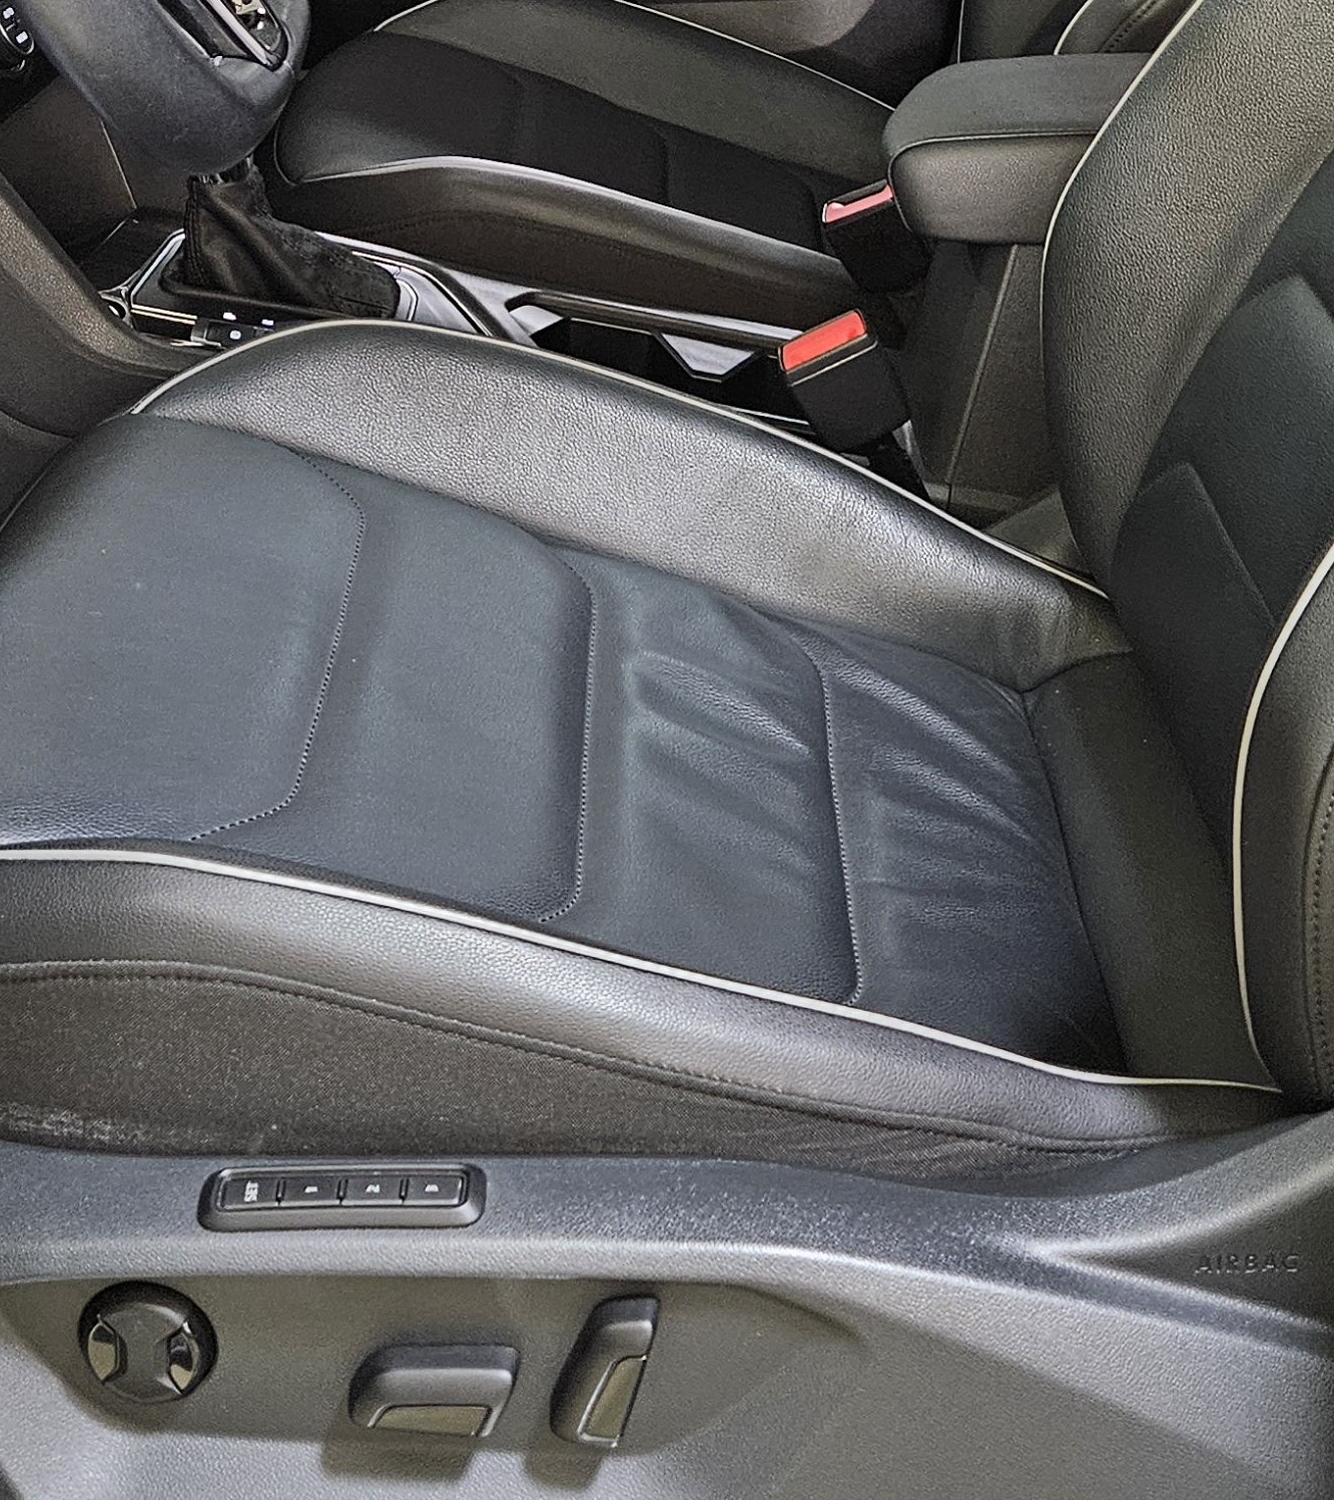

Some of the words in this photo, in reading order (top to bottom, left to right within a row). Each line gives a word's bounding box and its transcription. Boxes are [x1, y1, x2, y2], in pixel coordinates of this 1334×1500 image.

[243, 1180, 259, 1202] SET
[365, 1184, 380, 1193] 2
[1195, 1252, 1301, 1275] AIRBAG
